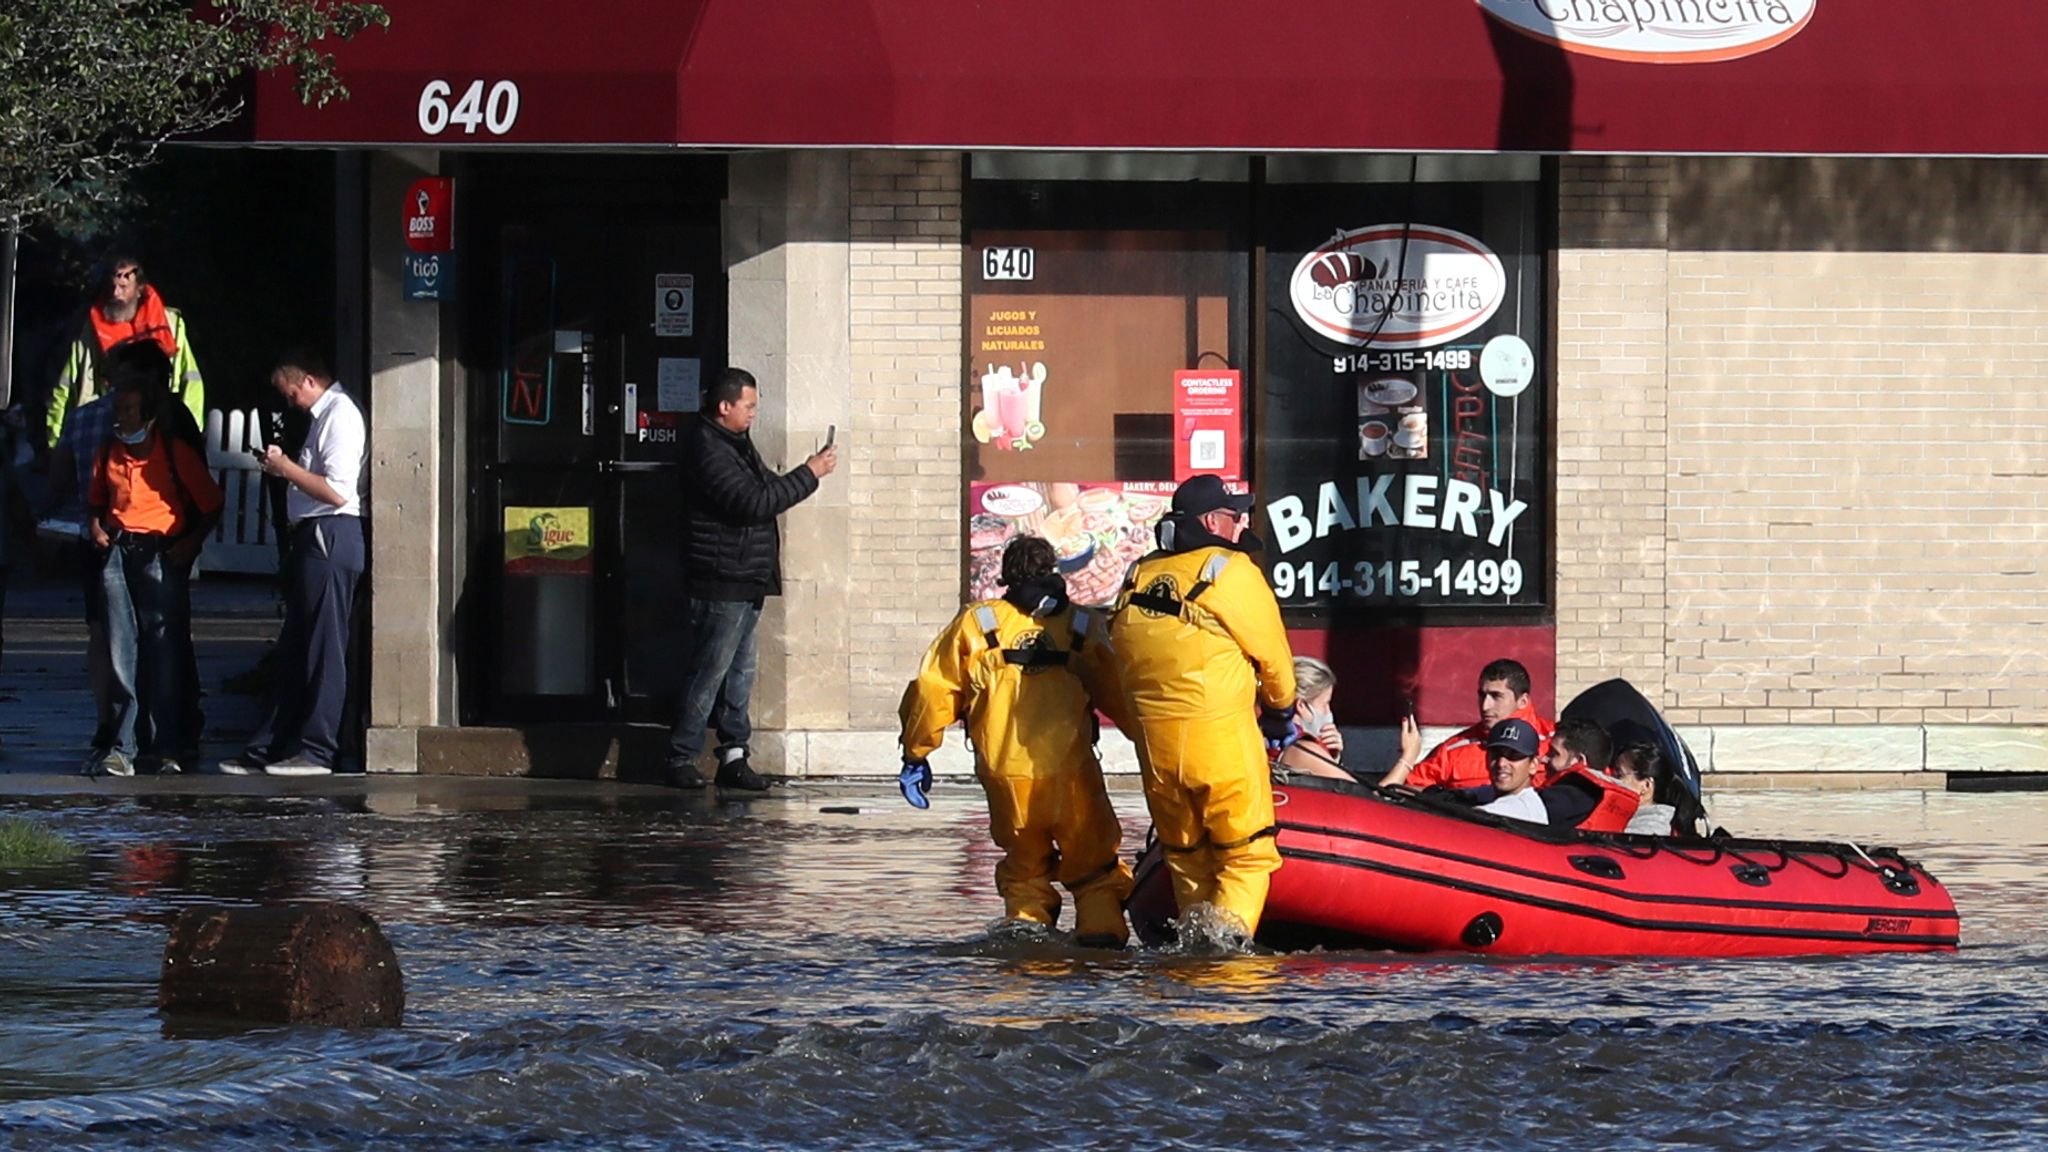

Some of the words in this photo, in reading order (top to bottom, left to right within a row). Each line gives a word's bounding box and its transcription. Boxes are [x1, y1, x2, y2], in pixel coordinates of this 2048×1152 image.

[418, 80, 519, 134] 640
[409, 216, 435, 231] BOSS
[986, 248, 1031, 277] 640
[1312, 286, 1332, 301] La
[1334, 284, 1482, 319] Chapincita
[990, 311, 1026, 320] JUGOS
[1029, 311, 1037, 320] Y
[986, 325, 1040, 335] LICUADOS
[982, 340, 1045, 350] NATURALES
[1333, 350, 1471, 373] 914-315-1499
[639, 428, 676, 442] PUSH
[1266, 473, 1528, 554] BAKERY
[528, 512, 575, 547] Sigue
[1273, 559, 1523, 598] 914-315-1499
